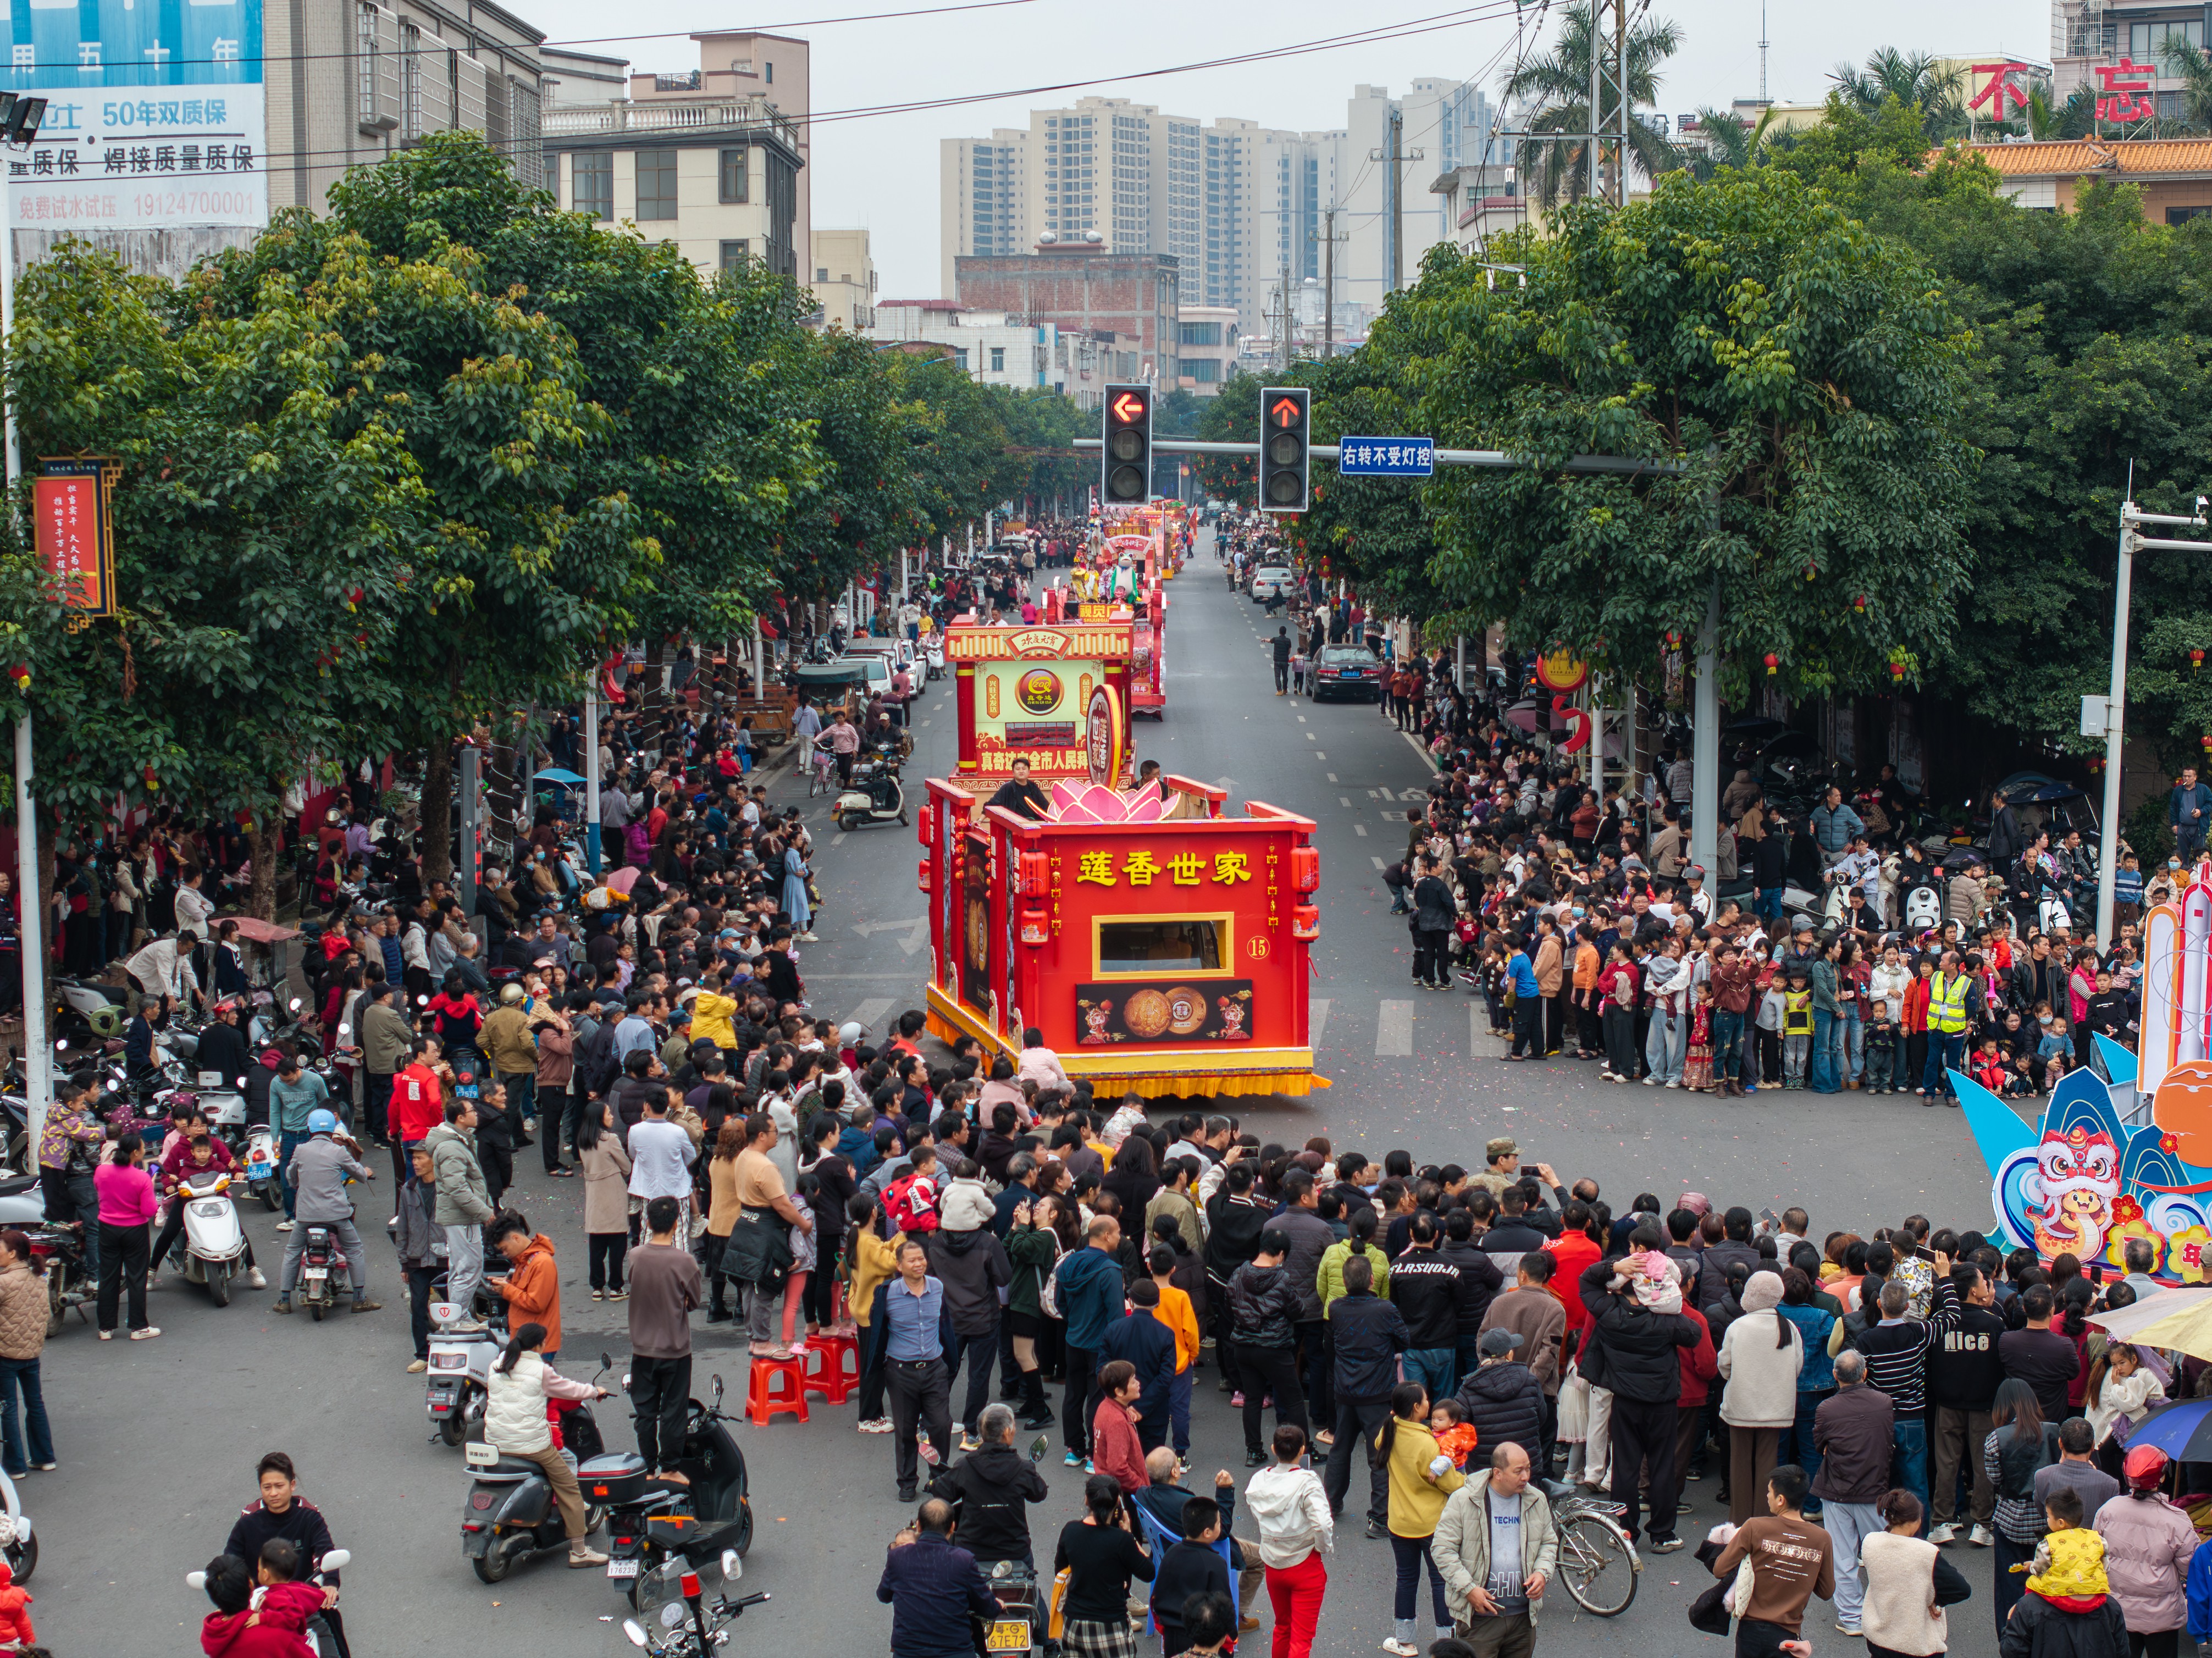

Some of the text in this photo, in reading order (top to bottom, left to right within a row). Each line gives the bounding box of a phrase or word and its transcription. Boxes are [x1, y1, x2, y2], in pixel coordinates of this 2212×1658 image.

[1968, 57, 2155, 122] 不忘
[103, 99, 227, 127] 50年双质保
[104, 144, 254, 172] 焊接质量质保
[19, 191, 253, 220] 免费试水试压 19124700001
[1343, 445, 1431, 467] 右转不受灯控
[1080, 605, 1133, 618] 视觉广
[1076, 850, 1252, 887] 莲香世家
[1251, 940, 1266, 957] 15
[1944, 1331, 1989, 1351] Nice
[990, 1635, 1026, 1648] 67E72
